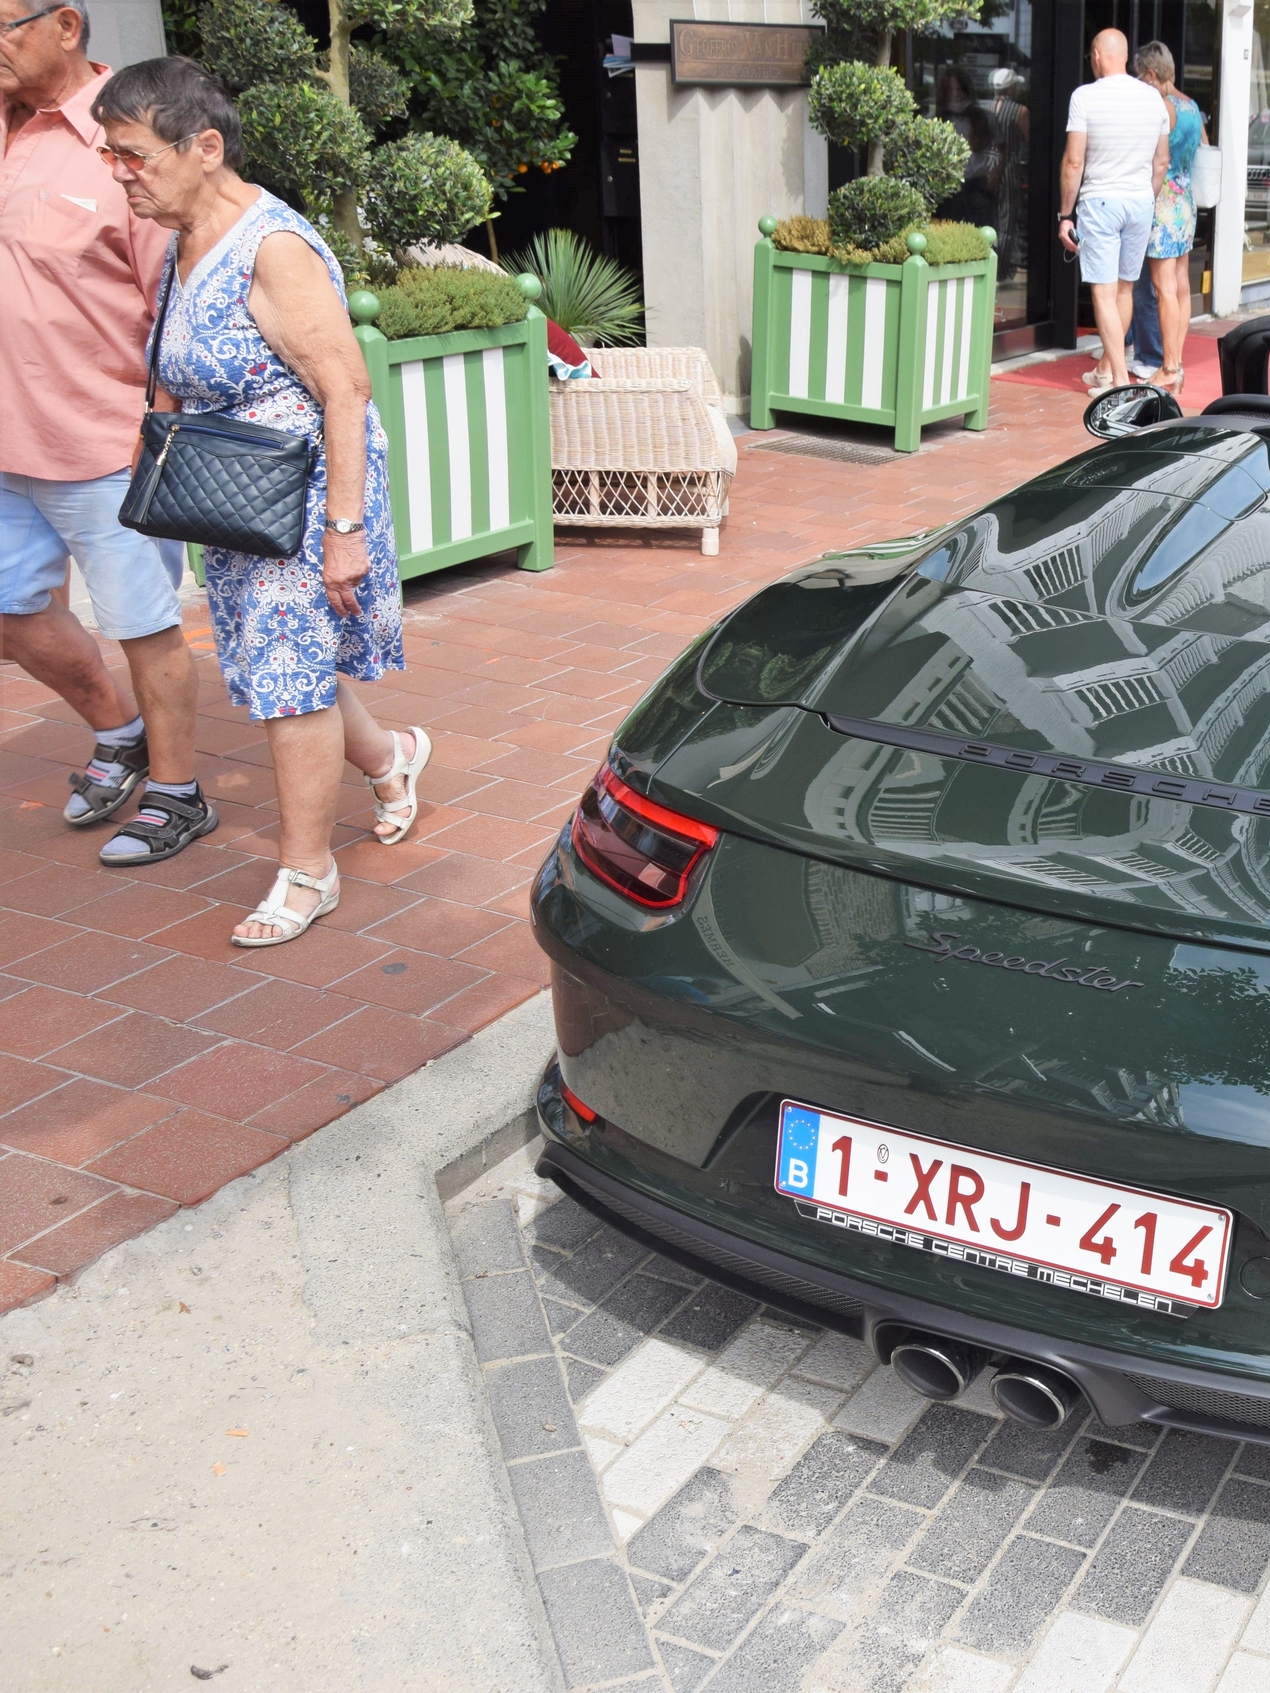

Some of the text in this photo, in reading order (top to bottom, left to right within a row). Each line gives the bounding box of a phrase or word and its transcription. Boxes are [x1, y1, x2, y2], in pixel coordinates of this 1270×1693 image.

[903, 931, 1145, 992] Speedster
[788, 1158, 809, 1188] B
[831, 1135, 1214, 1288] 1-XRJ-414
[816, 1207, 1173, 1313] PORSCHE CENTRE MECHELEN
